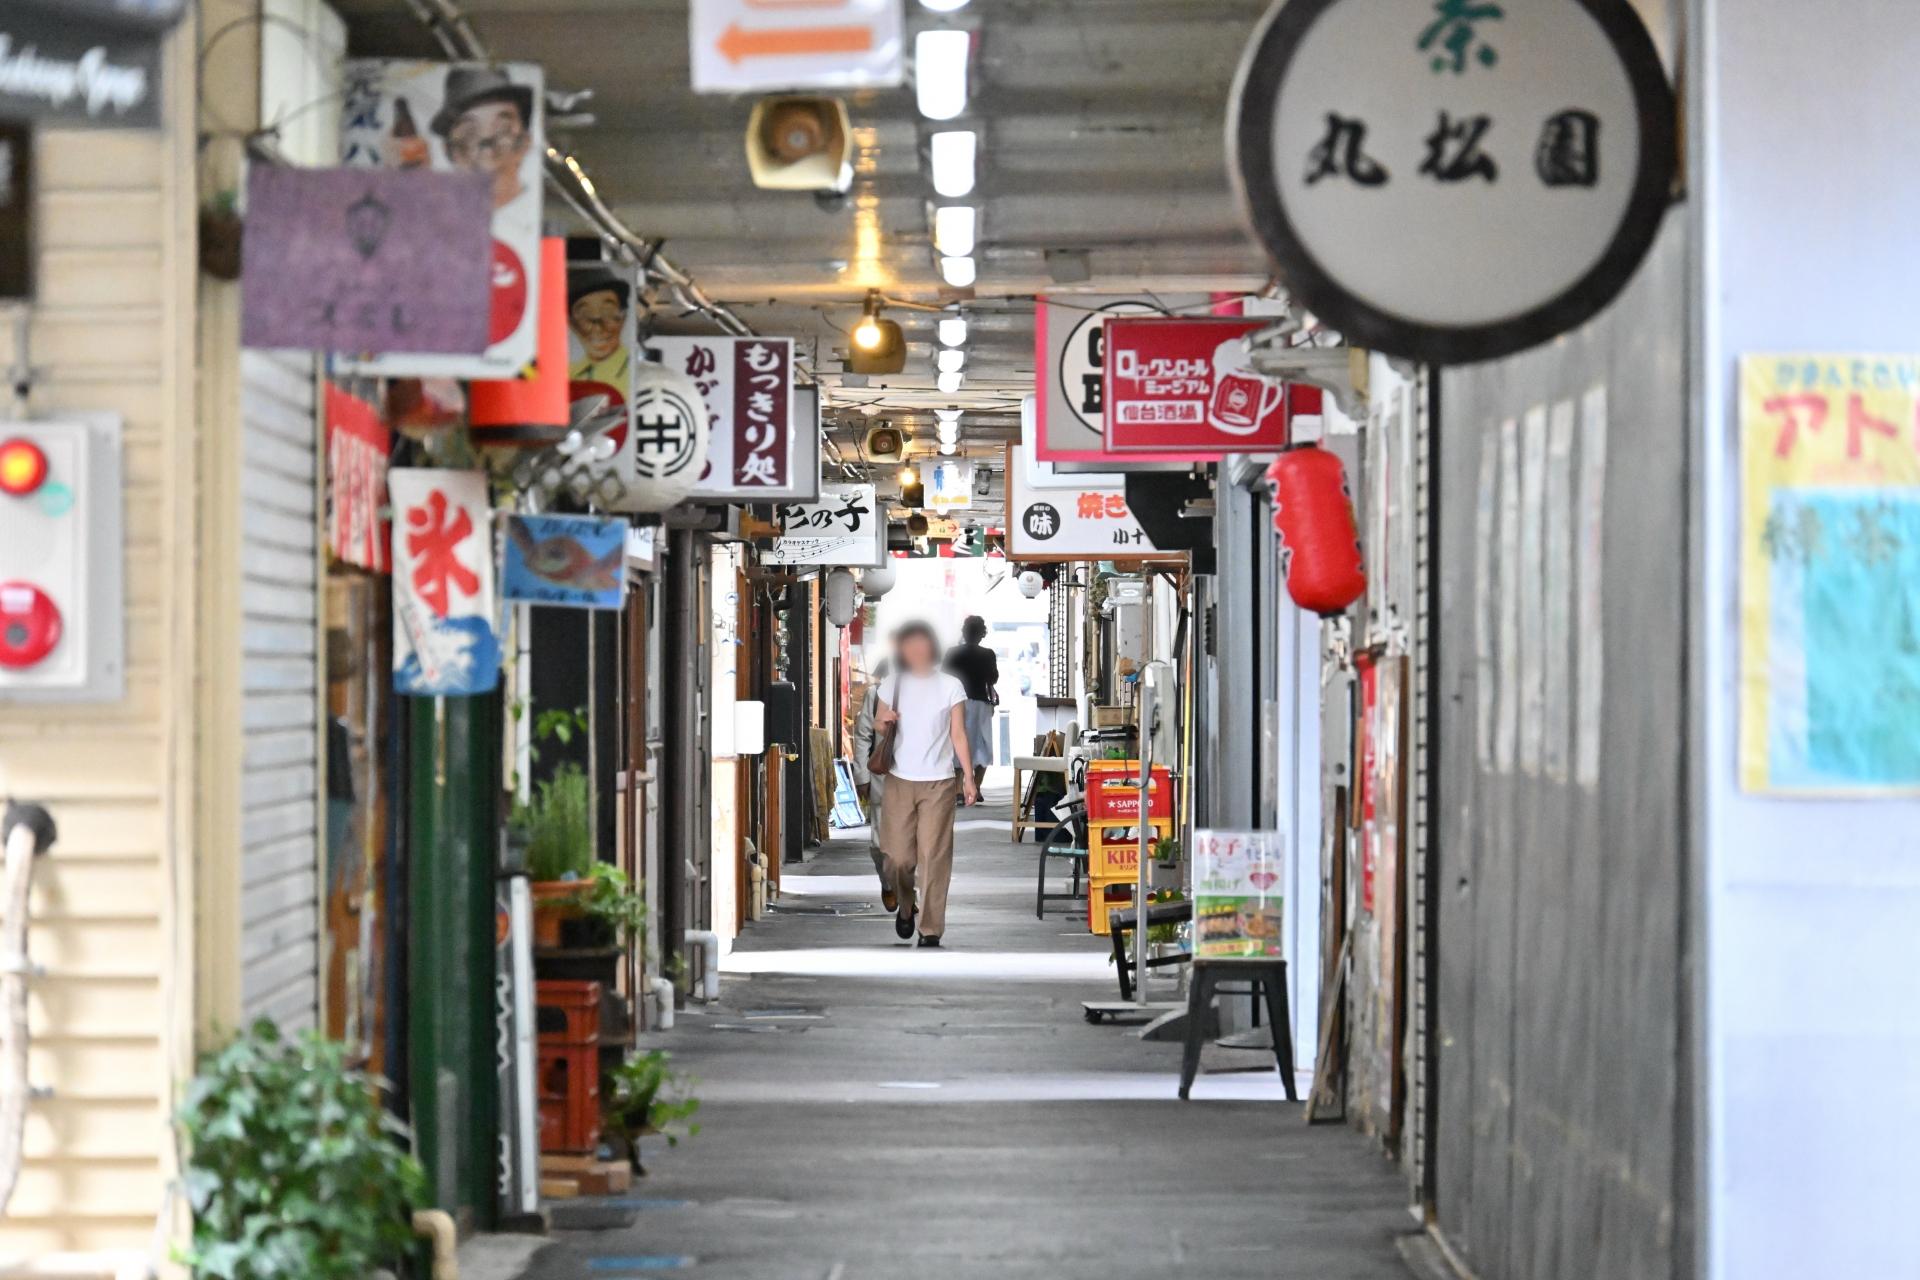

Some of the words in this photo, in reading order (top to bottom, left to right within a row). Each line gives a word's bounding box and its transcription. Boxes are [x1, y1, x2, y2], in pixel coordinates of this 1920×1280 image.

[1116, 350, 1209, 378] ロックンロール
[1145, 378, 1210, 396] ミュージアム
[1123, 404, 1198, 422] 仙台酒場
[1762, 392, 1920, 459] アト
[1077, 493, 1128, 519] 焼き
[1030, 511, 1053, 536] 味
[406, 489, 480, 617] 氷
[1116, 799, 1154, 809] SAPPO
[1107, 849, 1153, 865] KIR
